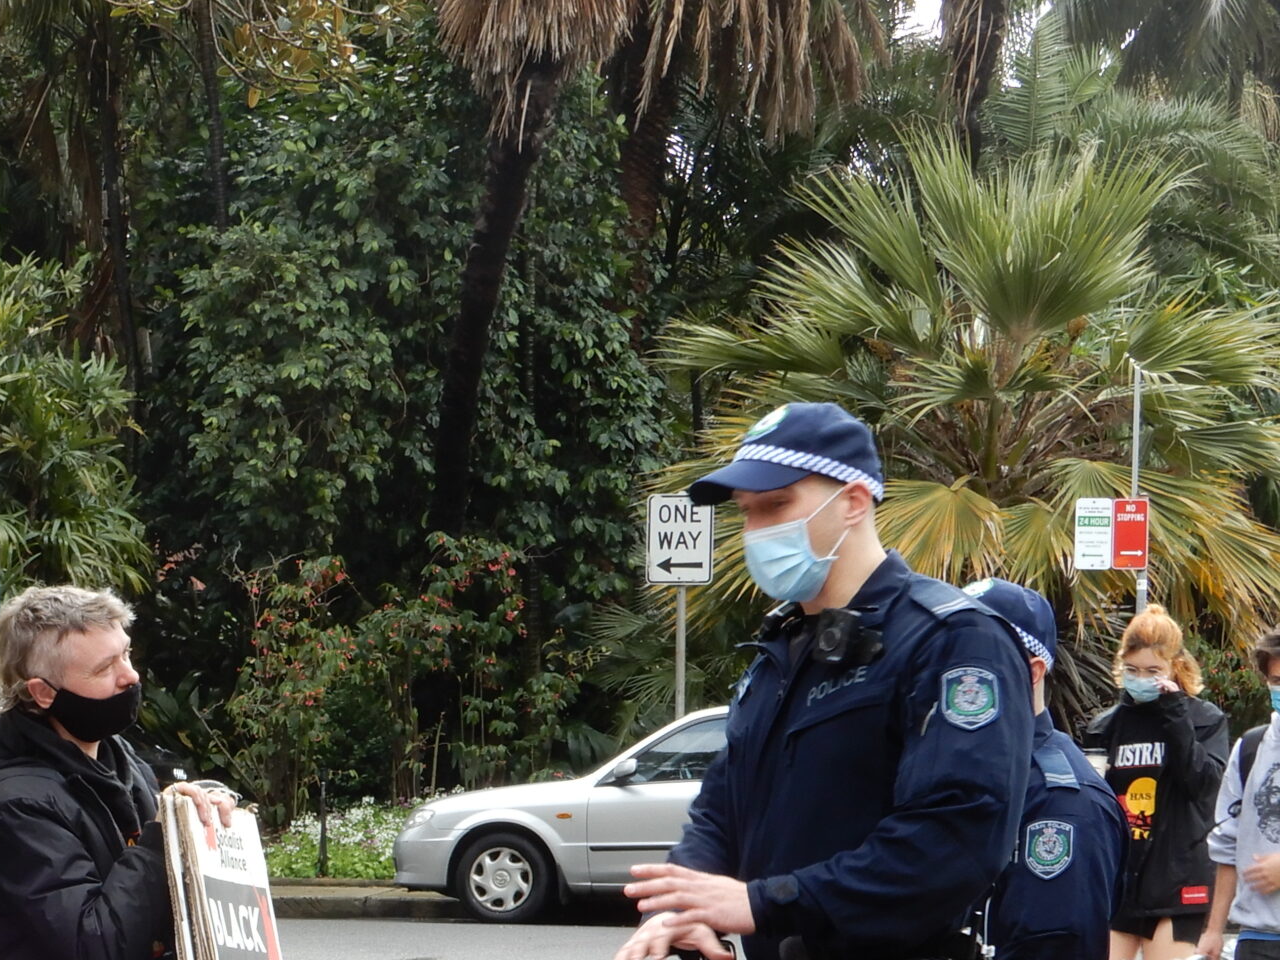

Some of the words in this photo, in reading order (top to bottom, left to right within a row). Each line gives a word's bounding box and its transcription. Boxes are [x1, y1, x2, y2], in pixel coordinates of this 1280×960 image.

[658, 504, 702, 523] ONE
[1117, 513, 1145, 521] STOPPING
[1125, 504, 1136, 512] NO
[658, 531, 702, 550] WAY
[1115, 742, 1165, 767] USTRA
[1130, 793, 1152, 801] HAS
[220, 849, 247, 872] Alliance
[209, 897, 267, 953] BLACK
